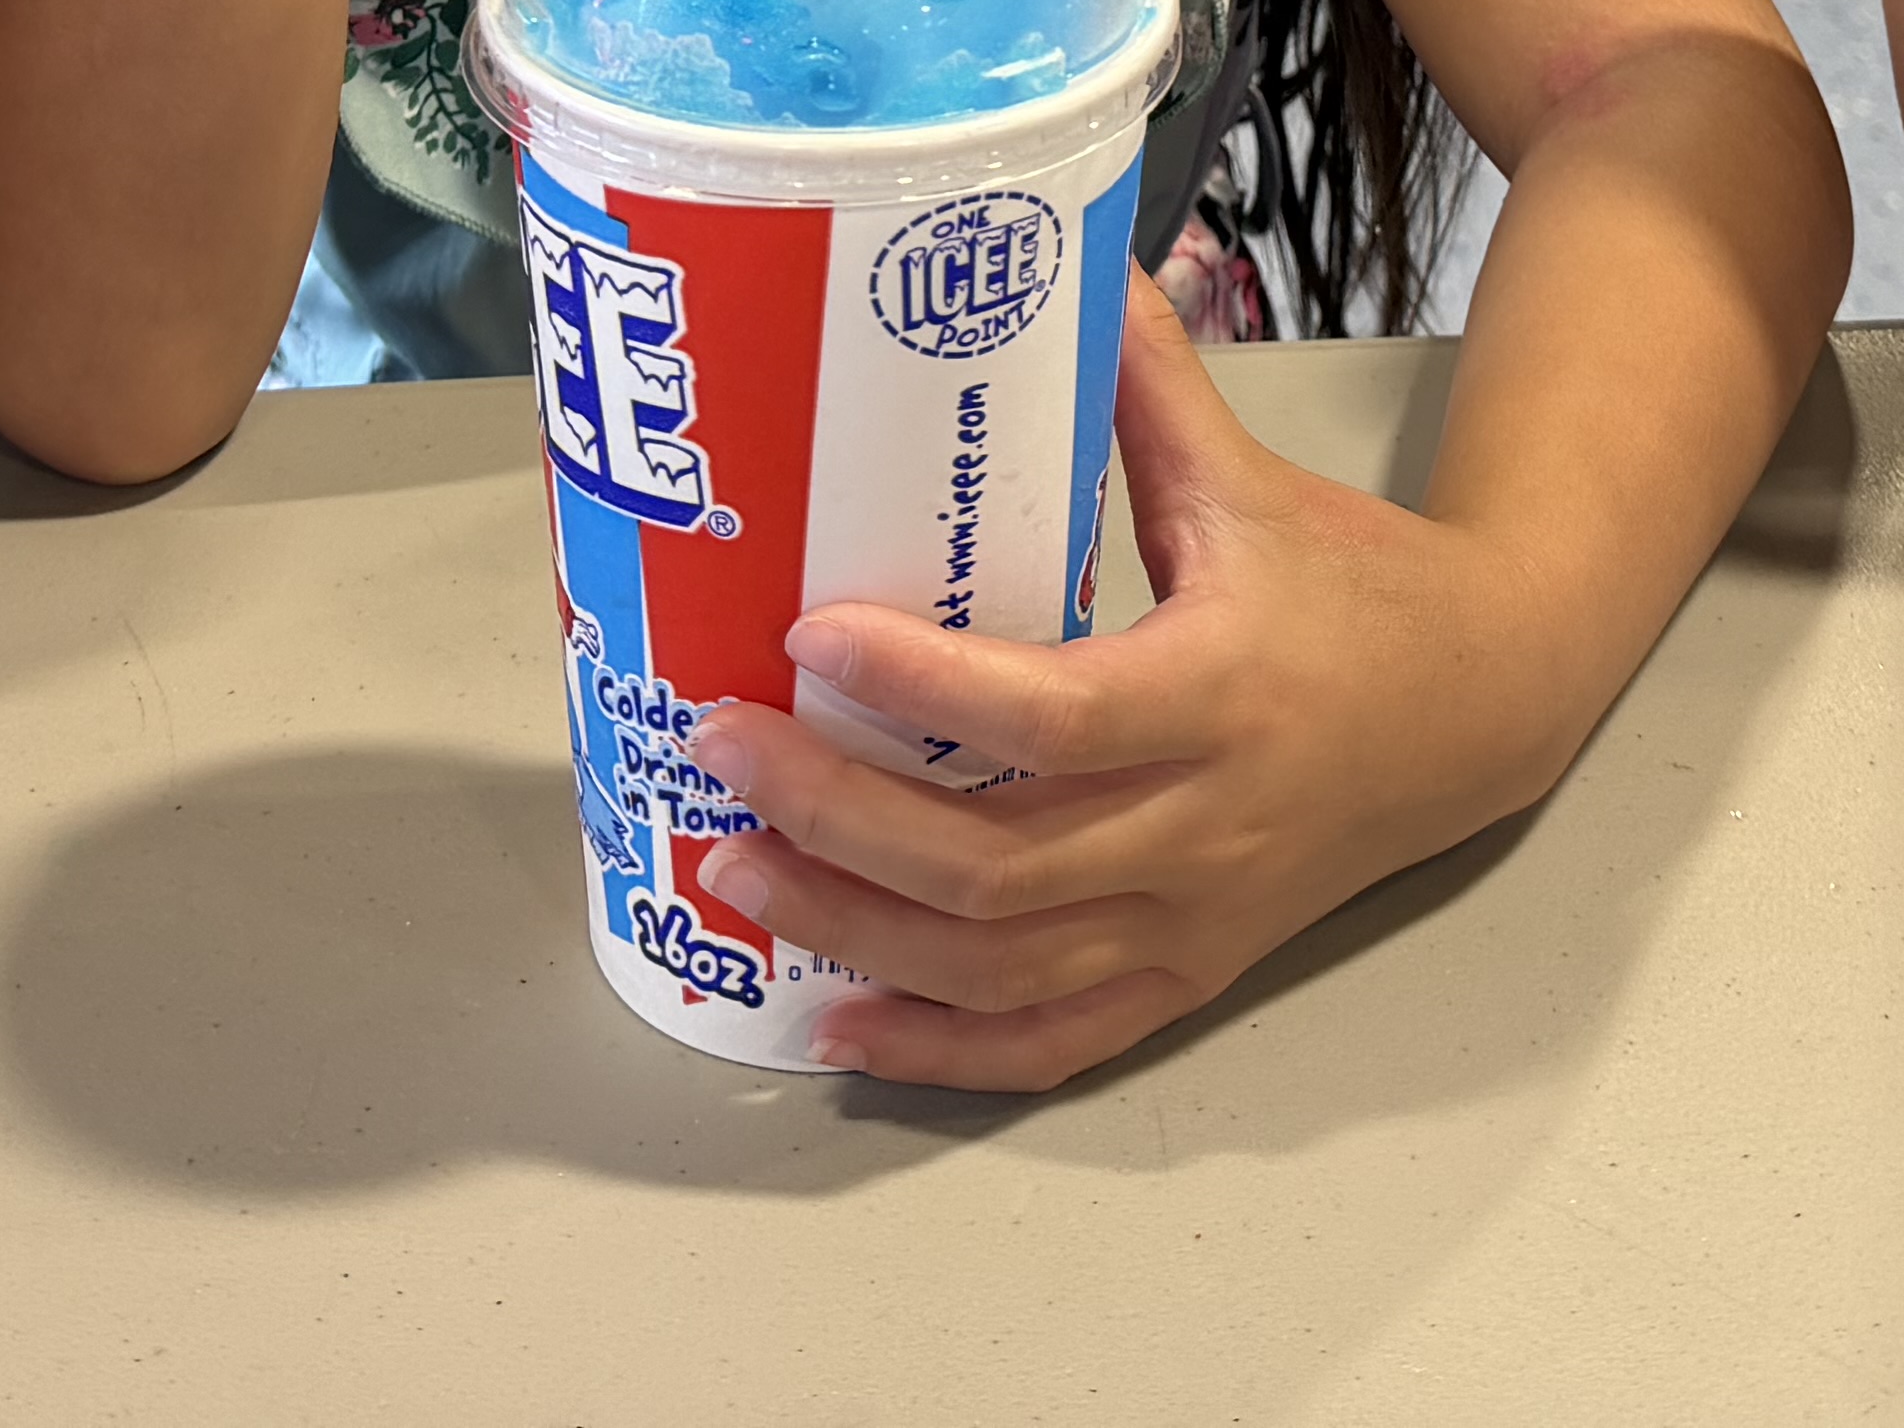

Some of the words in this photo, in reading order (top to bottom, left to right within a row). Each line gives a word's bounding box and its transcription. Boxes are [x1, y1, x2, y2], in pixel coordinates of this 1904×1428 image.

[931, 206, 991, 239] ONE
[899, 212, 1041, 331] ICEE
[936, 300, 1026, 350] POINT
[937, 382, 990, 585] www.icee.com
[934, 590, 974, 630] at
[597, 675, 714, 740] Colde
[620, 774, 650, 820] in
[658, 789, 759, 835] Town
[633, 899, 765, 1008] 16oz.
